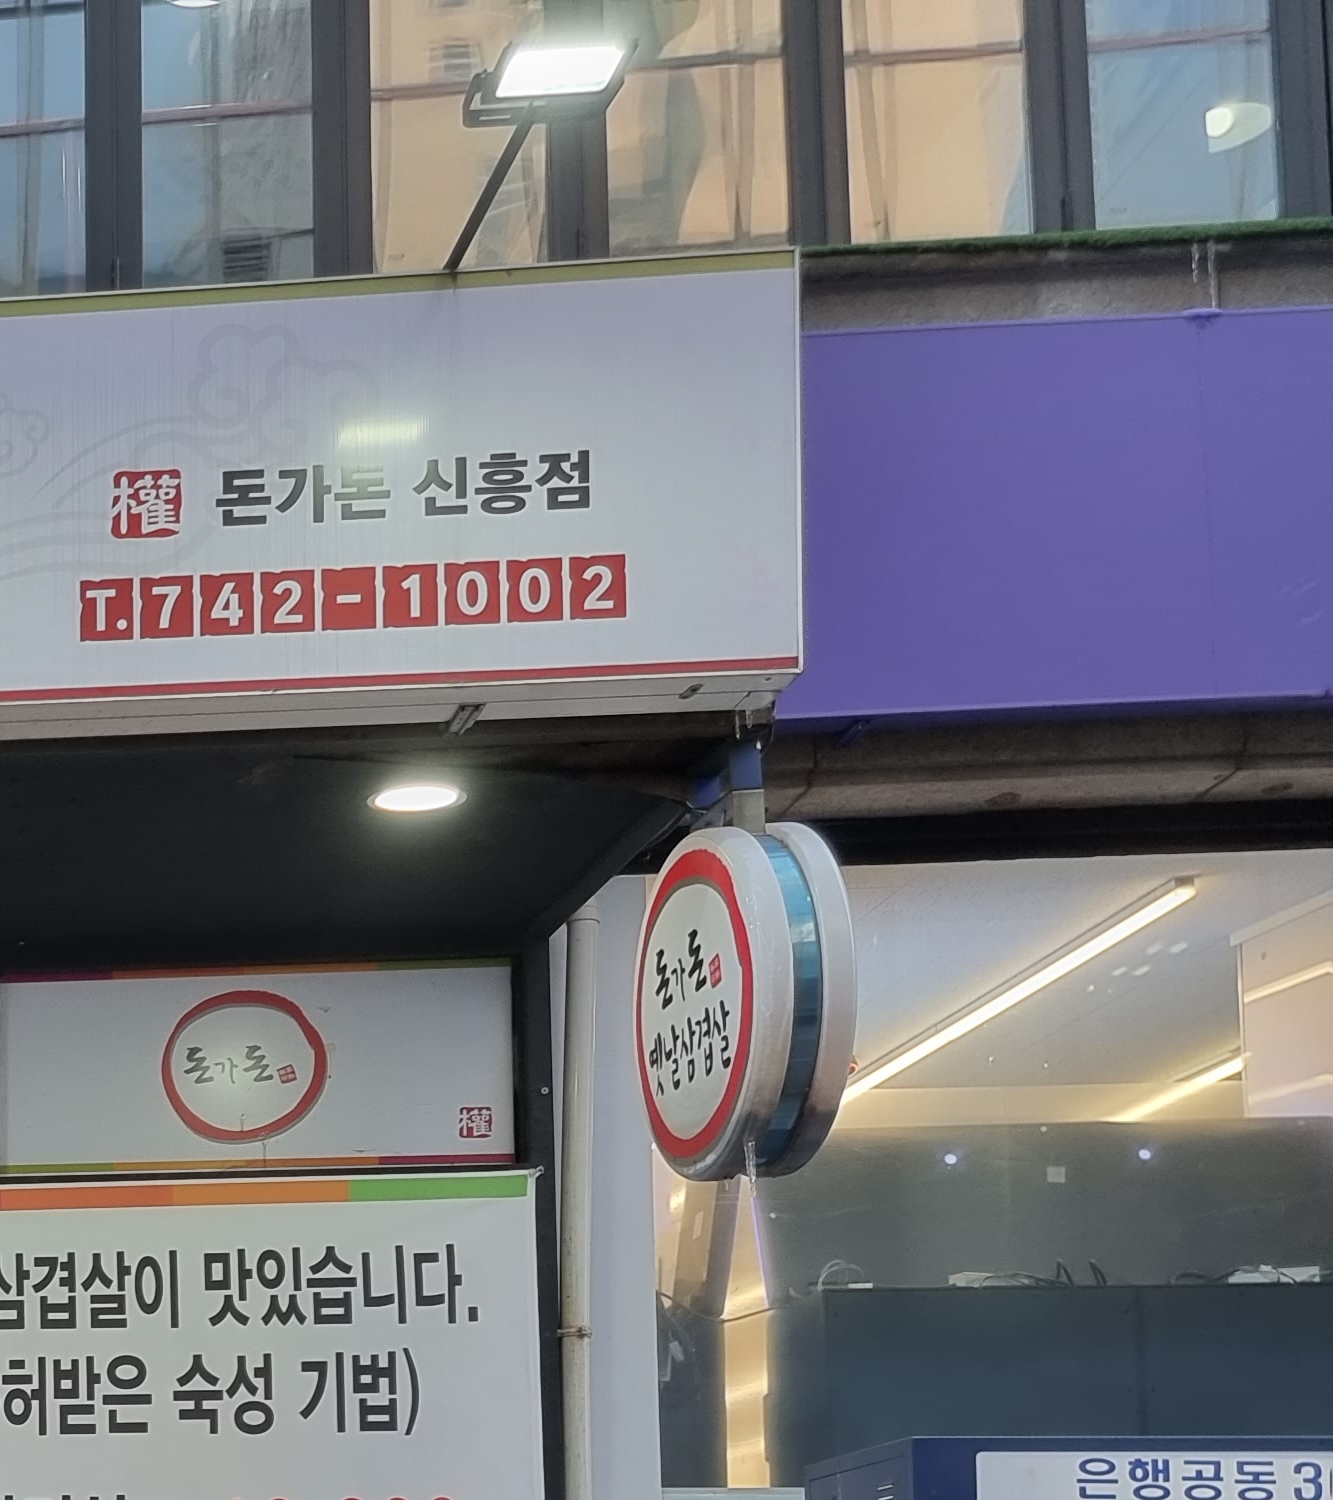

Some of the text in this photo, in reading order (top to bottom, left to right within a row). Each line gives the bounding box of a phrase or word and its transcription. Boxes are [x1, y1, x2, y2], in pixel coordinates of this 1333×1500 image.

[215, 449, 591, 527] 돈가돈 신흥점
[85, 564, 615, 632] T.742-1002
[654, 929, 708, 1010] 돈가돈
[183, 1045, 274, 1084] 돈가돈
[648, 1000, 731, 1097] 옛날삼겹살
[203, 1243, 480, 1327] 맛있습니다.
[172, 1352, 275, 1435] 숙성
[300, 1347, 420, 1434] 기법)
